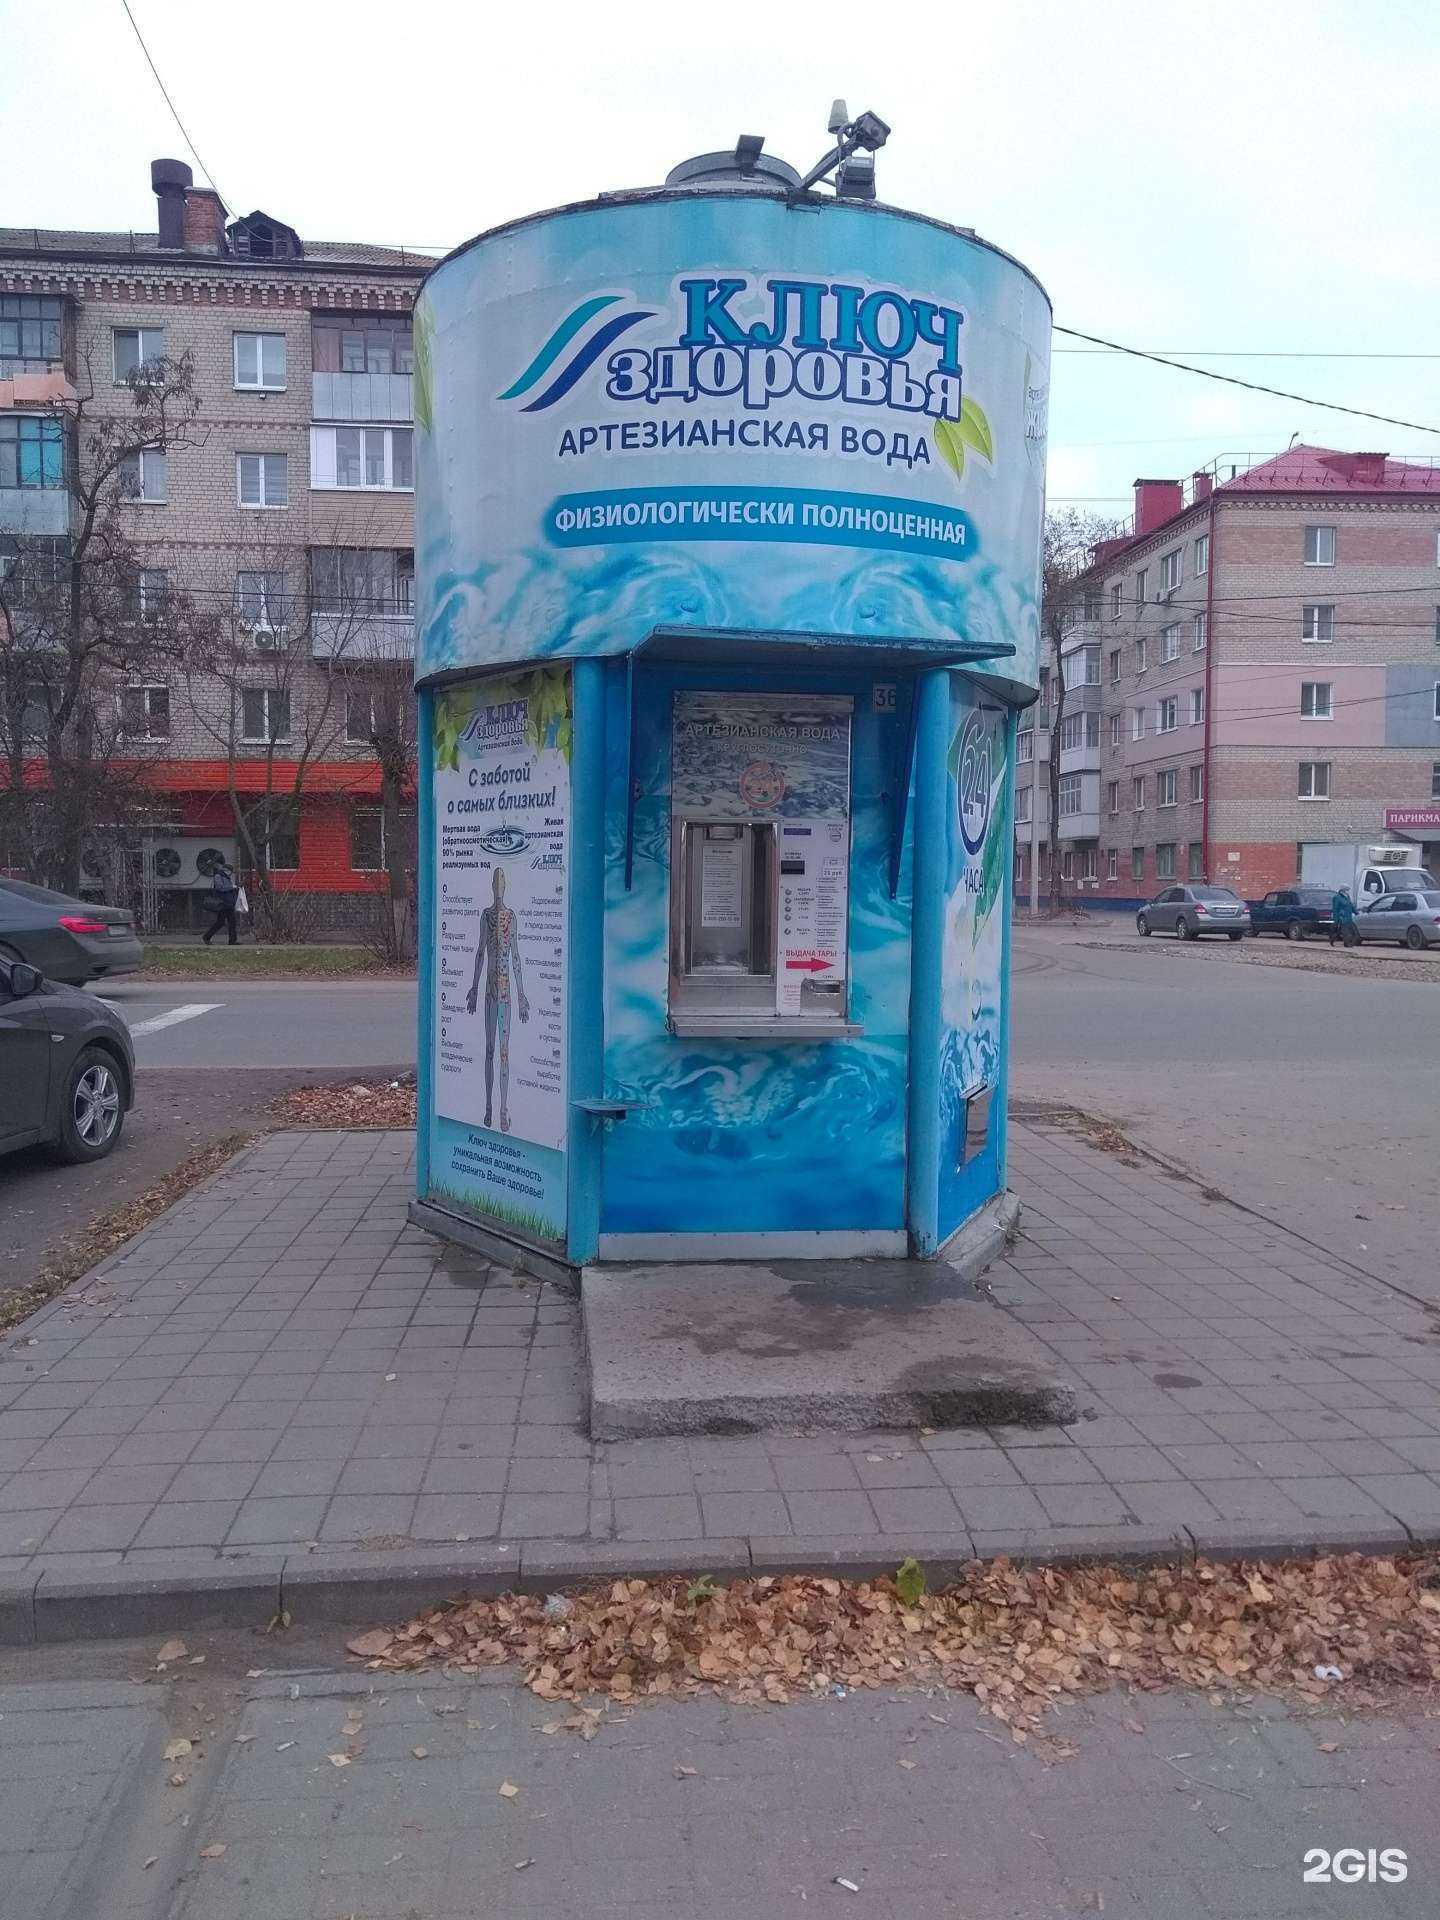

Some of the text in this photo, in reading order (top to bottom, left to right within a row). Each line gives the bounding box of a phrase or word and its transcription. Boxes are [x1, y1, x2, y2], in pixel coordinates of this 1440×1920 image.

[680, 279, 963, 372] КЛЮЧ
[606, 345, 962, 422] здоровья
[558, 419, 931, 469] АРТЕЗИАНСКАЯ ВОДА
[555, 500, 966, 546] ФИЗИОЛОГИЧЕСКИ ПОЛНОЦЕННАЯ
[486, 699, 528, 725] КЛЮЧ
[686, 723, 840, 741] АРТЕЗИАНСКАЯ ВОДА
[468, 761, 530, 787] С заботой
[963, 744, 991, 818] 24
[447, 786, 556, 813] о самых близких!
[1391, 813, 1440, 823] ПАРИКМА
[963, 868, 985, 895] ЧАСА
[785, 949, 816, 958] ВЫДАЧА
[468, 1133, 487, 1149] Ключ
[489, 1141, 521, 1158] здоровья
[453, 1146, 542, 1183] уникальная возможность
[451, 1160, 545, 1200] сохранить Ваше здоровье!
